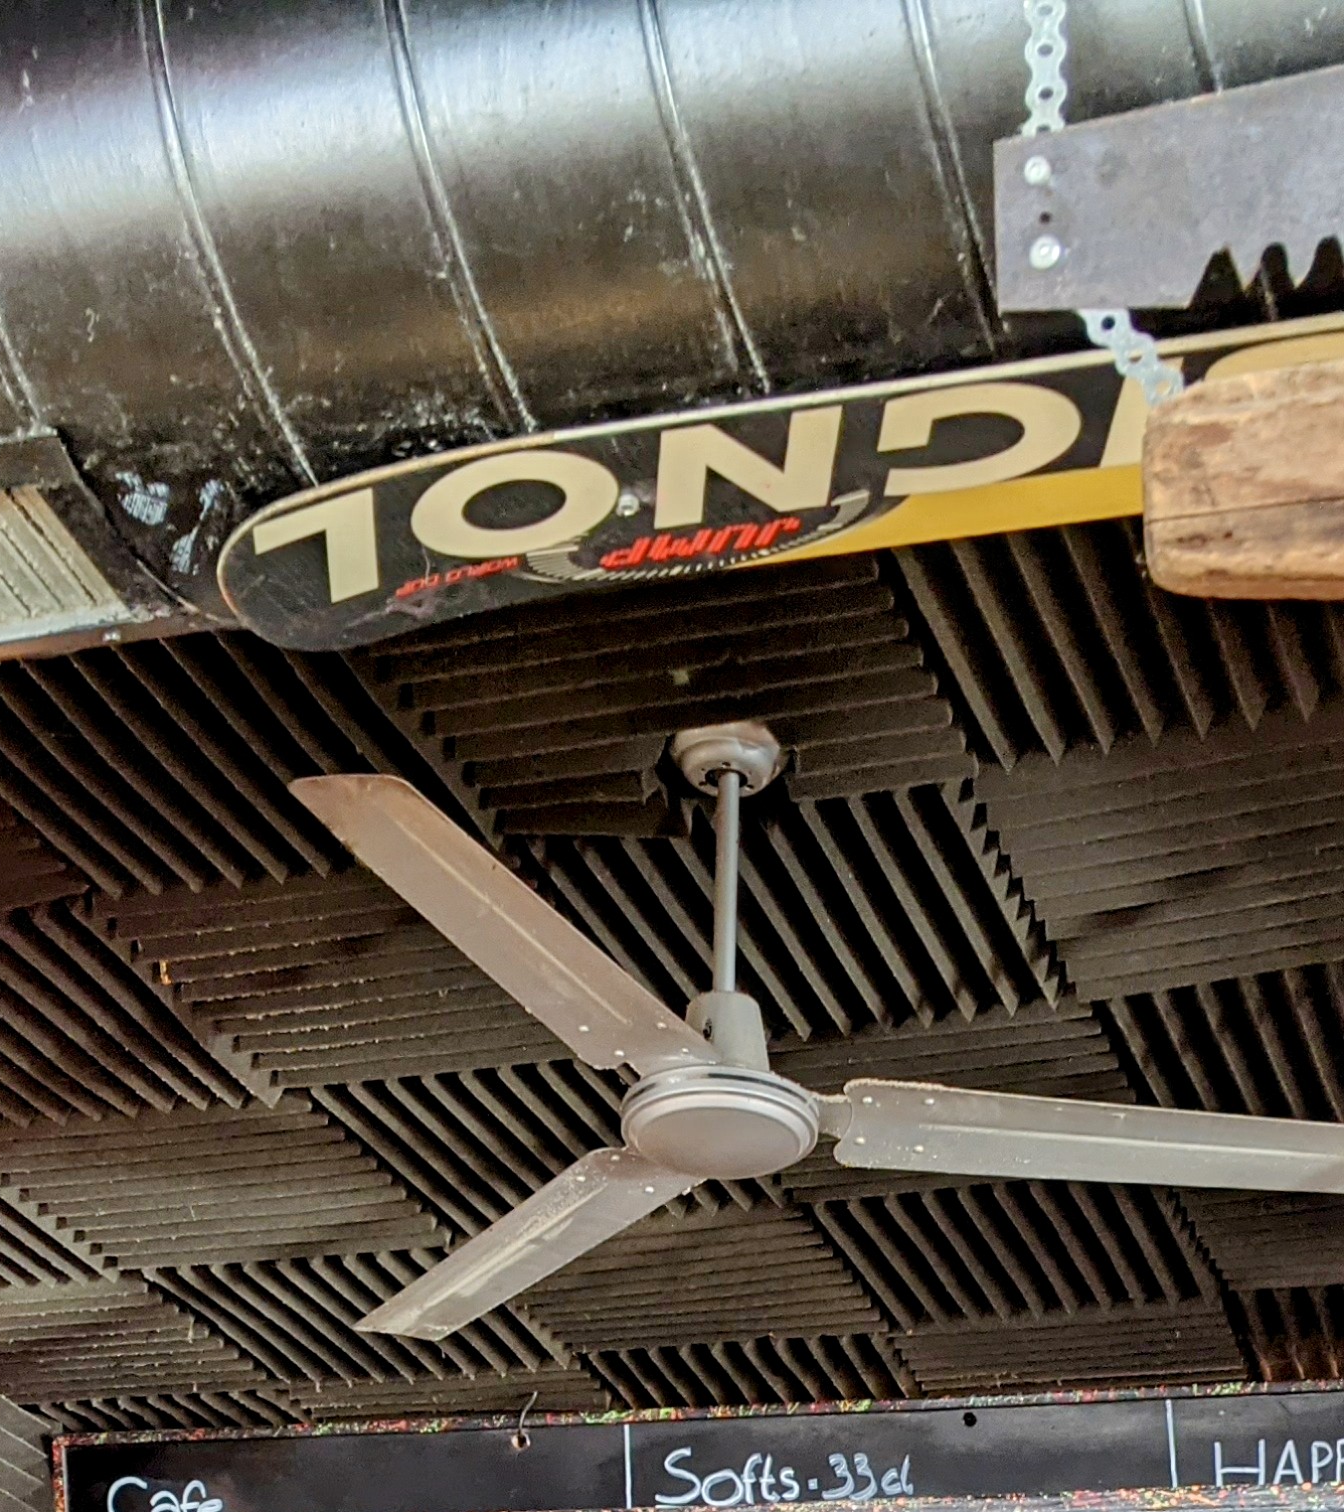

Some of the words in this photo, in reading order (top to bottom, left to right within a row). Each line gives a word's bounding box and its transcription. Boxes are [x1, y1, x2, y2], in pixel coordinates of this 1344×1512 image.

[600, 516, 802, 570] JUMP
[395, 573, 441, 599] CUP
[445, 555, 518, 583] WORLD
[658, 1446, 800, 1507] Softs
